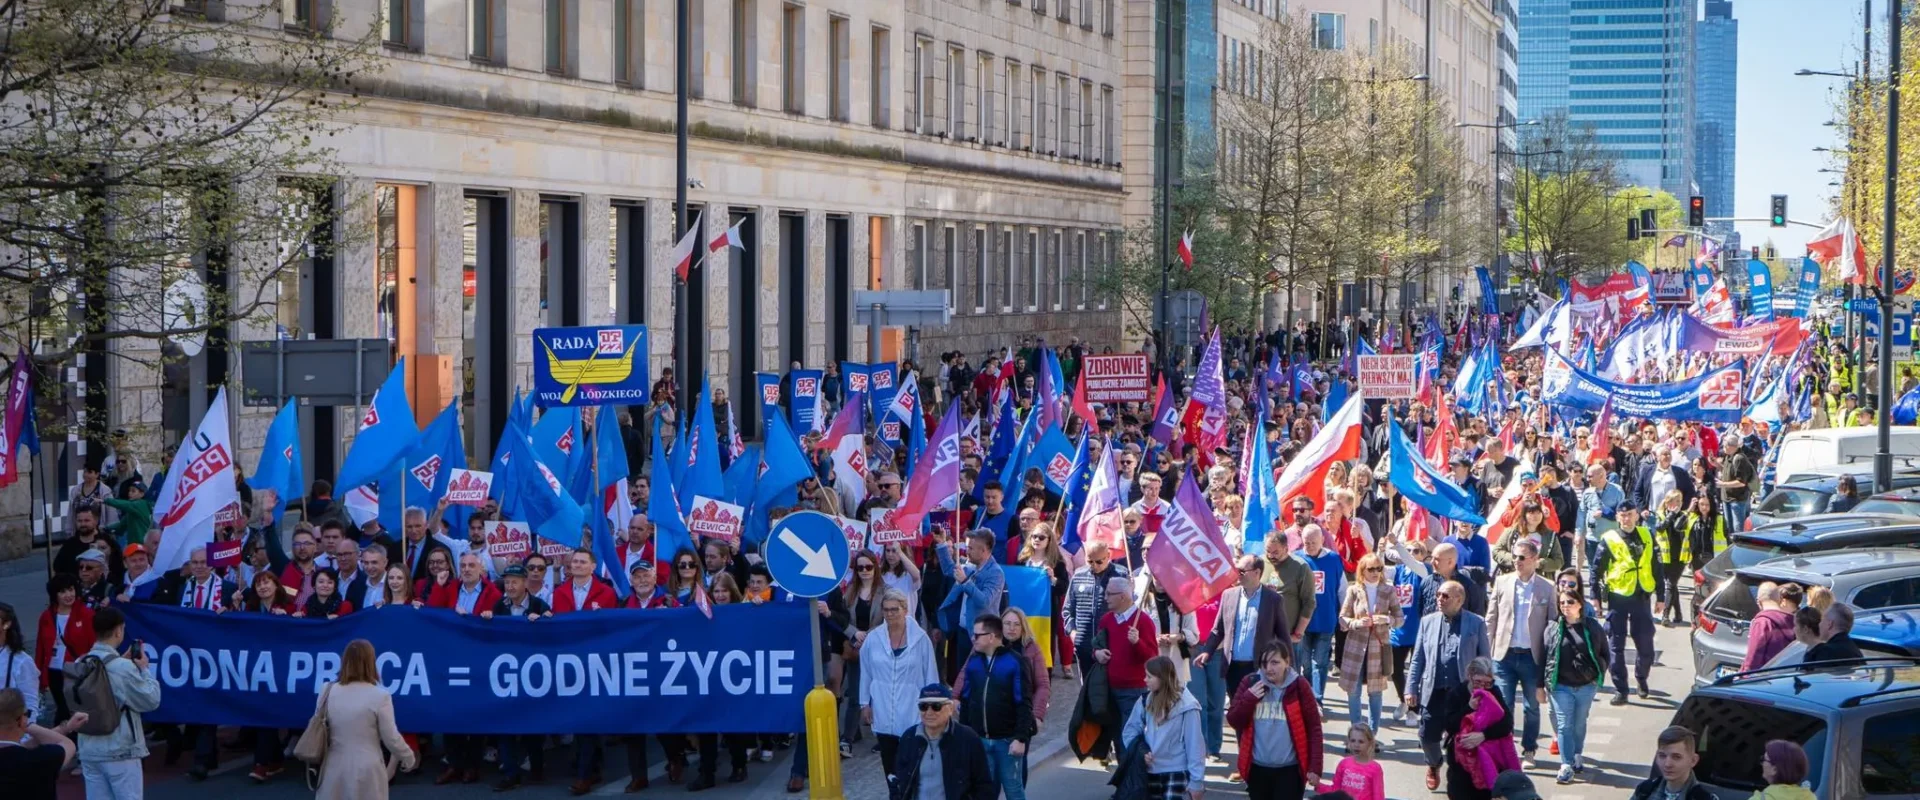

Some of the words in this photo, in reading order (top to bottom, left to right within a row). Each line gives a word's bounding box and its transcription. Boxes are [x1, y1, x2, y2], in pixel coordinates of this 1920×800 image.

[552, 337, 595, 350] RADA
[1719, 340, 1760, 348] LEWICA
[1088, 358, 1145, 375] ZDROWIE
[1361, 357, 1379, 370] NIECH
[1361, 371, 1395, 384] PIERWSZY
[1397, 371, 1412, 384] MAJ
[580, 389, 642, 400] ŁÓDZKIEGO
[451, 491, 481, 499] LEWICA
[696, 521, 731, 532] LEWICA
[215, 548, 240, 559] LEWICA
[493, 543, 524, 553] LEWICA
[544, 544, 575, 554] LEWIC
[287, 651, 431, 696] PRCA
[489, 652, 650, 698] GODNE
[660, 638, 795, 696] ŻYCIE
